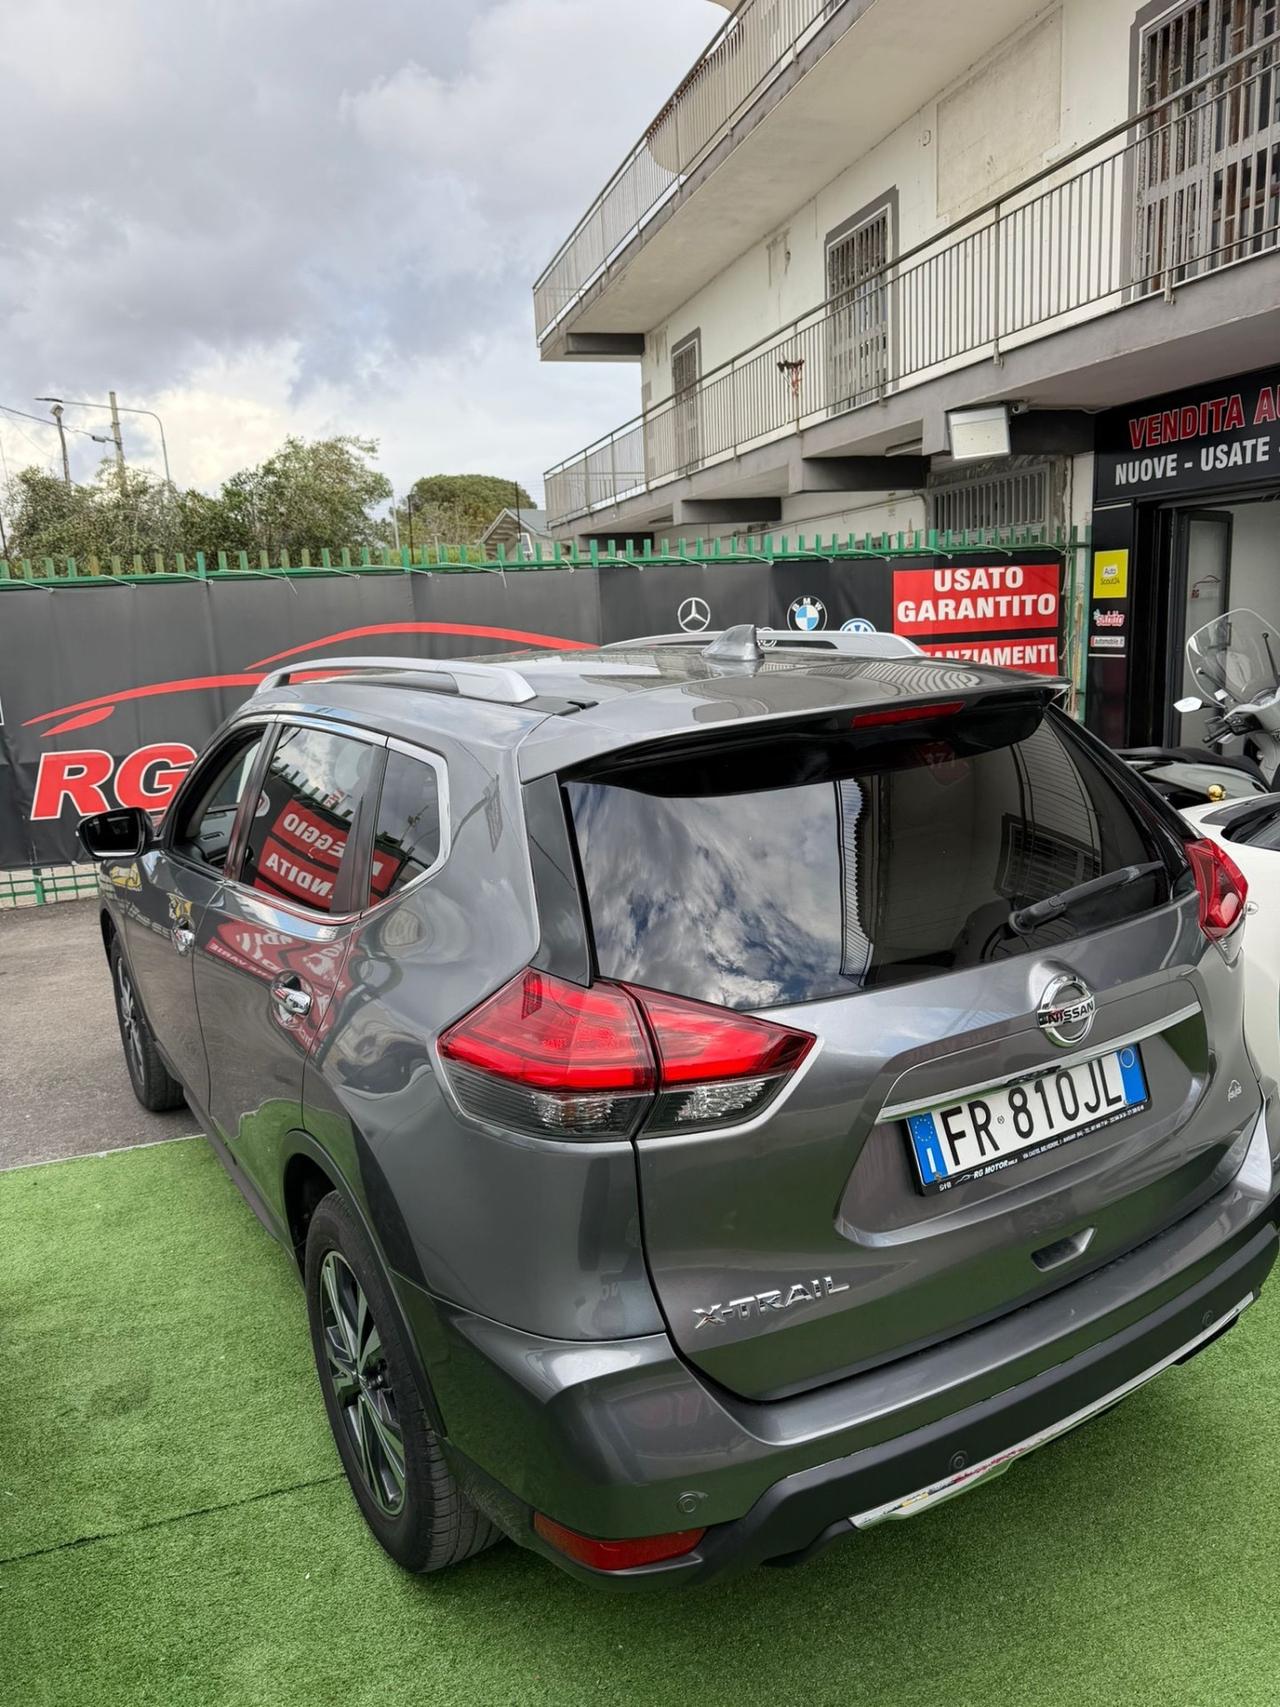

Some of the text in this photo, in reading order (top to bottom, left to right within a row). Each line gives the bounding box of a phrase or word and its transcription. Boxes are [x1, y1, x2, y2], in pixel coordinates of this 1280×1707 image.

[1129, 384, 1280, 449] VENDITA A
[1115, 453, 1178, 485] NUOVE
[1200, 436, 1271, 472] USATE
[933, 566, 1024, 592] USATO
[791, 597, 823, 612] BMW
[897, 593, 1057, 623] GARANTITO
[926, 644, 1056, 666] NZIAMENTI
[30, 742, 199, 821] RG
[1047, 1000, 1094, 1024] NISSAN
[939, 1099, 1000, 1167] FR
[1007, 1059, 1123, 1140] 810JL
[692, 1276, 850, 1329] X-TRAIL
